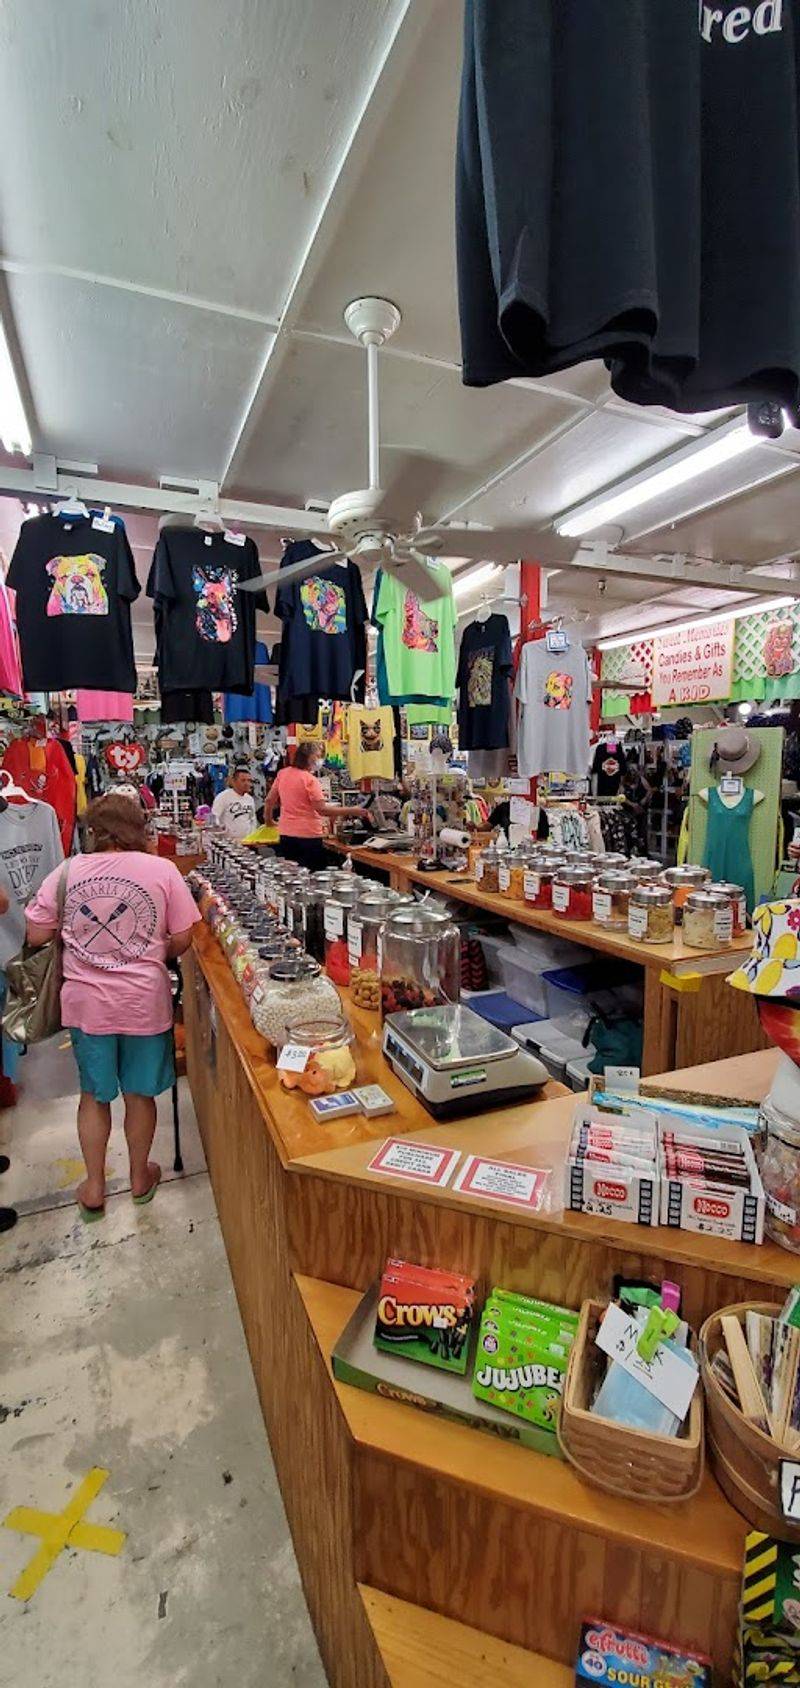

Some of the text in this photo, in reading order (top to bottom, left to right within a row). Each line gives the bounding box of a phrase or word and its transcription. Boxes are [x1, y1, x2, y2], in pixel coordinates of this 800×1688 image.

[658, 642, 727, 667] Candies & Gifts
[672, 665, 711, 682] Remember
[713, 662, 723, 677] As
[669, 685, 711, 702] A KID
[109, 745, 140, 769] ty
[378, 1296, 457, 1328] Crows
[607, 1667, 650, 1688] SOUR
